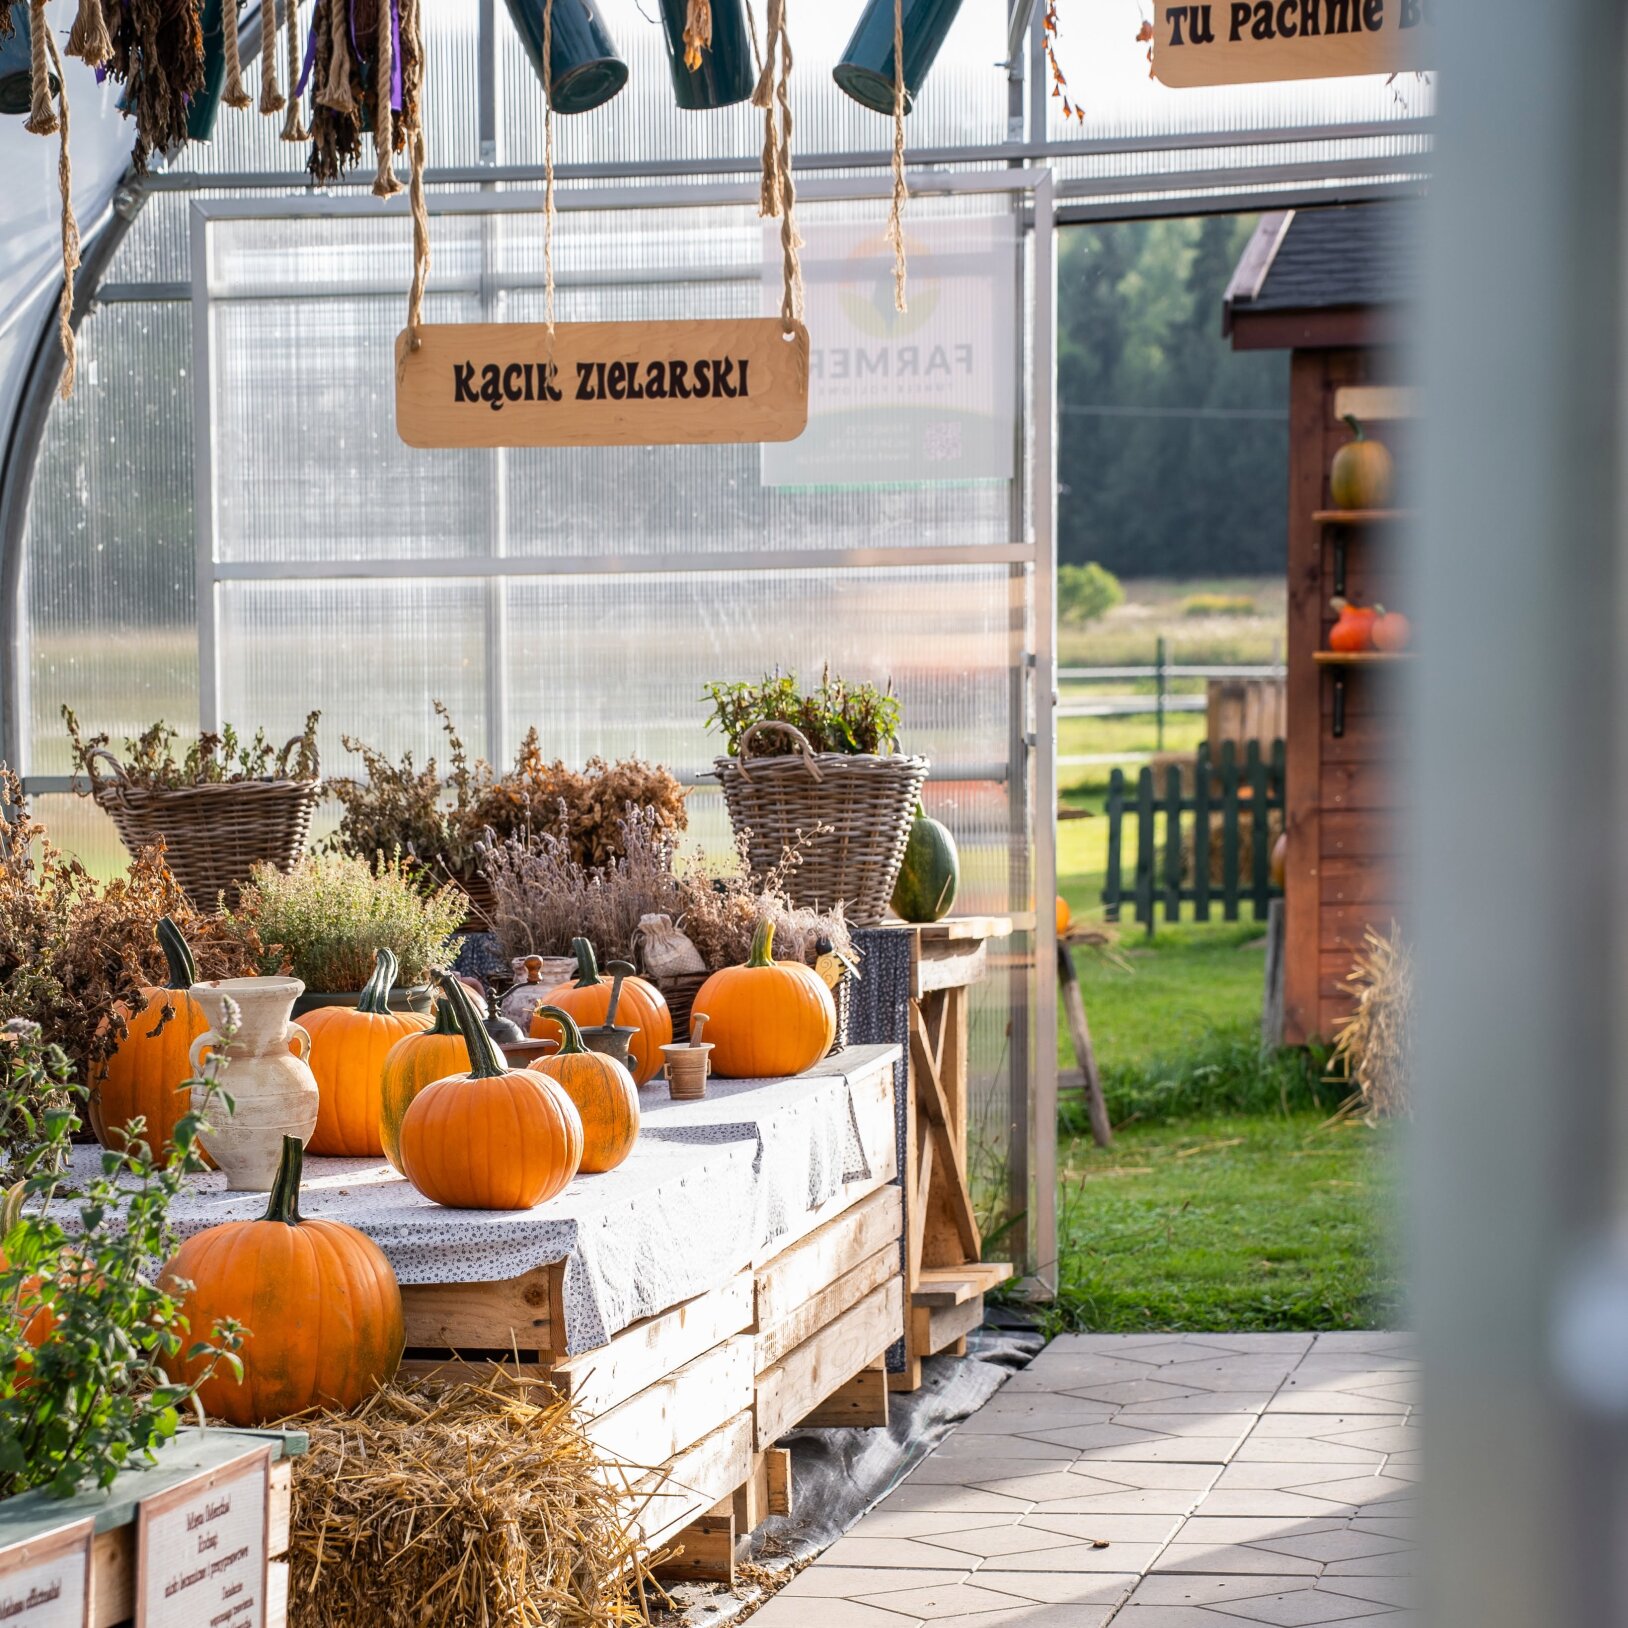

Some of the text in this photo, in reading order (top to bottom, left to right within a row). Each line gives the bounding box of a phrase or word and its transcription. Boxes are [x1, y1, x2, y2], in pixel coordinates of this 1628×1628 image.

[1166, 5, 1214, 46] TU
[453, 355, 749, 411] KĄCIK ZIELARSKI
